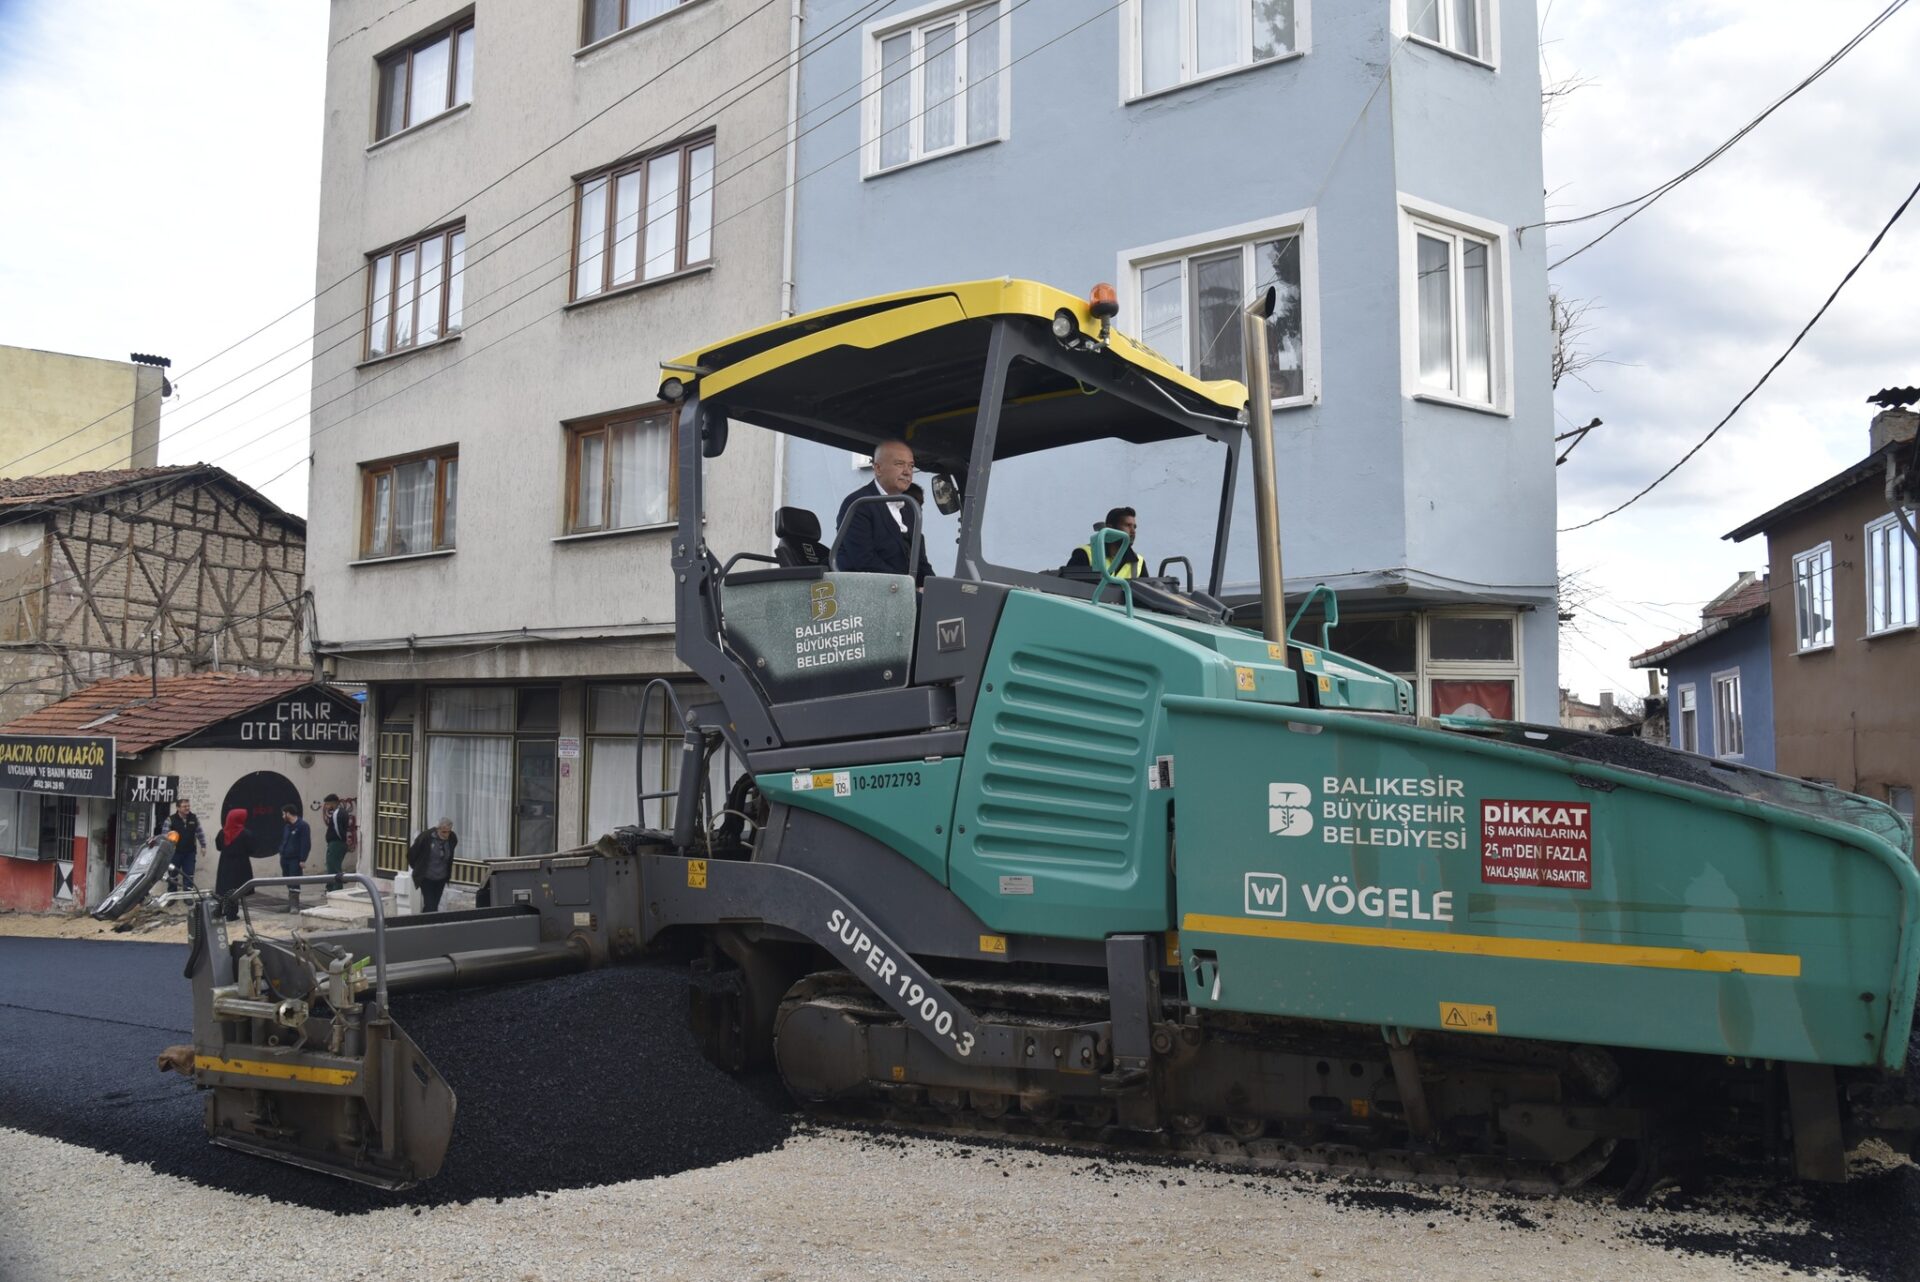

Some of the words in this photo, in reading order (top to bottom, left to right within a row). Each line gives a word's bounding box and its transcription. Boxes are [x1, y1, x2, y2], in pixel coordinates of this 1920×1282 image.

[795, 615, 864, 639] BALIKESİR
[796, 630, 864, 654] BÜYÜKŞEHİR
[797, 644, 866, 669] BELEDİYESİ
[241, 722, 280, 740] OTO
[292, 721, 359, 741] KUAFÖR
[35, 745, 56, 764] OTO
[57, 742, 105, 766] KUAFÖR
[8, 764, 37, 777] UYGULAMA
[47, 767, 66, 779] BAKIM
[67, 768, 93, 780] MERKEZİ
[137, 776, 167, 789] OTO
[853, 772, 921, 790] 10-2072793
[131, 788, 174, 802] YIKAMA
[1323, 775, 1465, 797] BALIKESİR
[1323, 798, 1465, 826] BÜYÜKŞEHİR
[1484, 802, 1588, 826] DİKKAT
[1323, 825, 1467, 850] BELEDİYESİ
[1485, 823, 1495, 838] İŞ
[1498, 825, 1588, 840] MAKİNALARINA
[1546, 846, 1588, 862] FAZLA
[1485, 865, 1539, 881] YAKLAŞMAK
[1541, 868, 1588, 883] YASAKTIR.
[1301, 875, 1454, 922] VÖGELE
[826, 909, 897, 986] SUPER
[898, 975, 975, 1056] 1900-3
